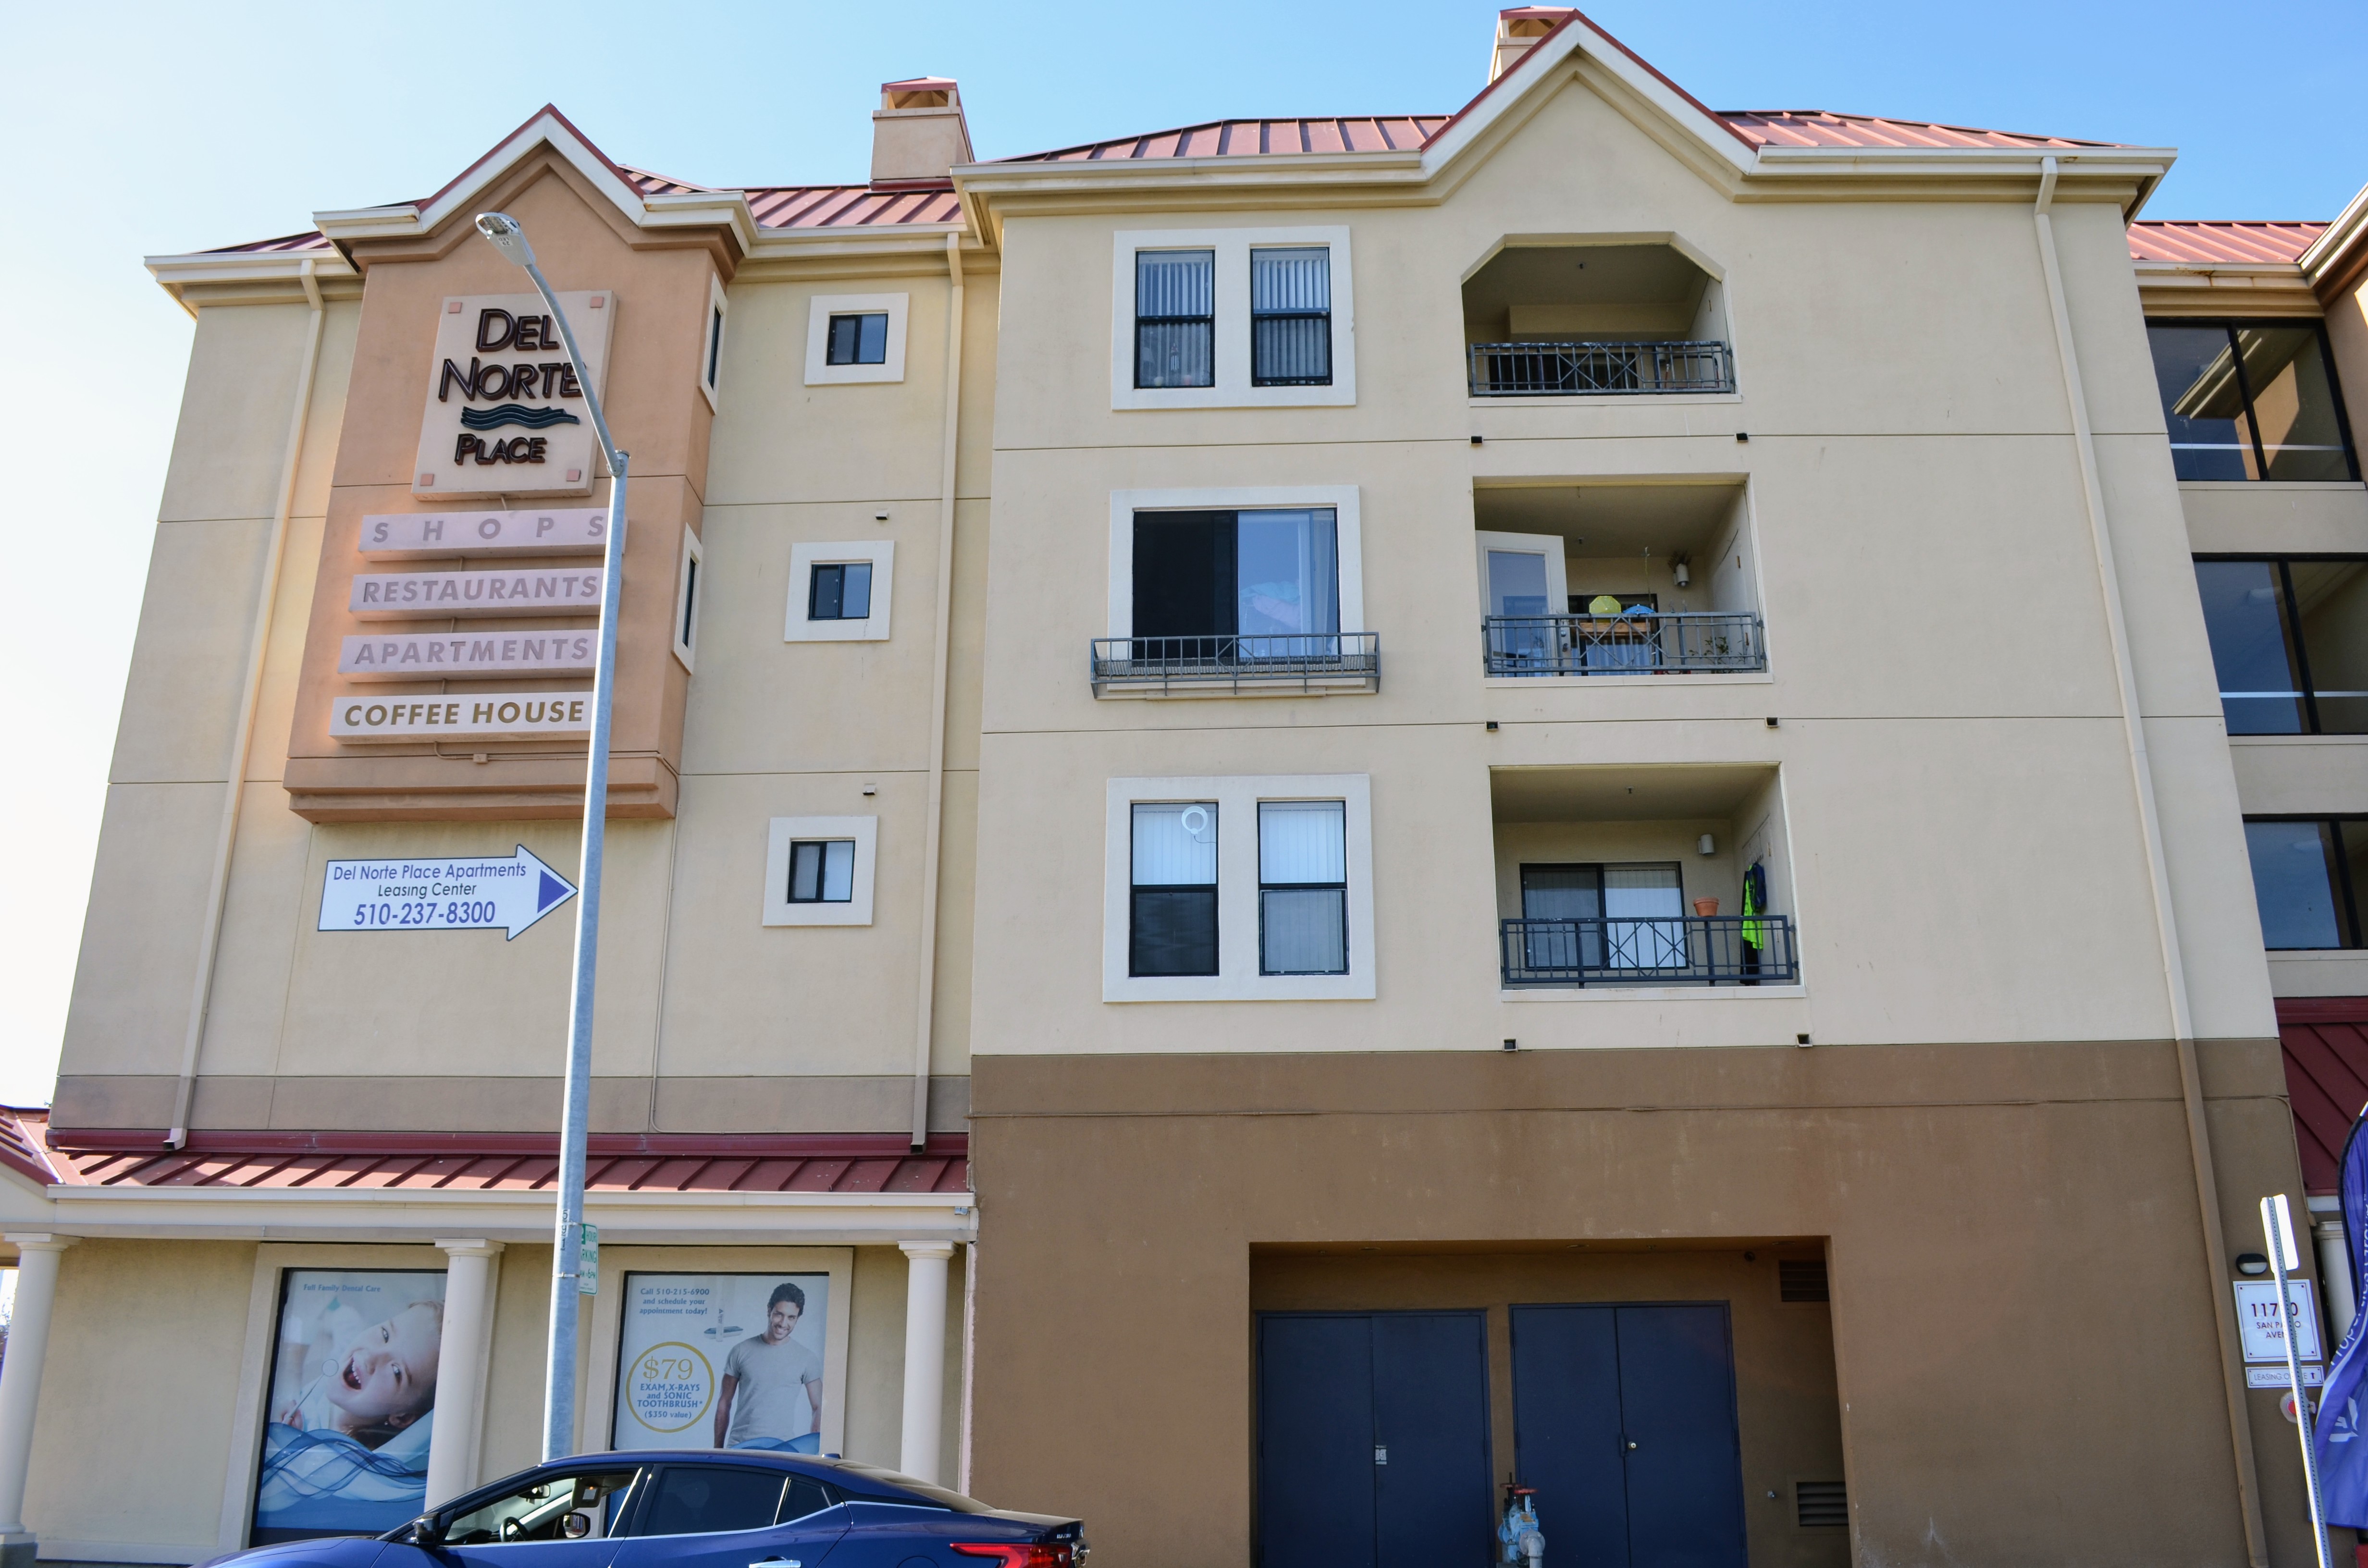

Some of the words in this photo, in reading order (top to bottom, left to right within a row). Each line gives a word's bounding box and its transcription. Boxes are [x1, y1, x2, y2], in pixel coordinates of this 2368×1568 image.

[363, 576, 597, 602] RESTAURANTS
[355, 638, 588, 664] APARTMENTS
[345, 703, 460, 726] COFFEE
[472, 701, 583, 723] HOUSE
[333, 866, 356, 880] Del
[360, 865, 397, 879] Norte
[402, 865, 440, 879] Place
[445, 862, 526, 881] Apartments
[378, 884, 427, 899] Leasing
[432, 882, 477, 896] Center
[354, 901, 495, 925] 510-237-8300
[580, 1249, 596, 1263] RKING
[2252, 1302, 2298, 1317] 1170
[643, 1356, 693, 1382] $79
